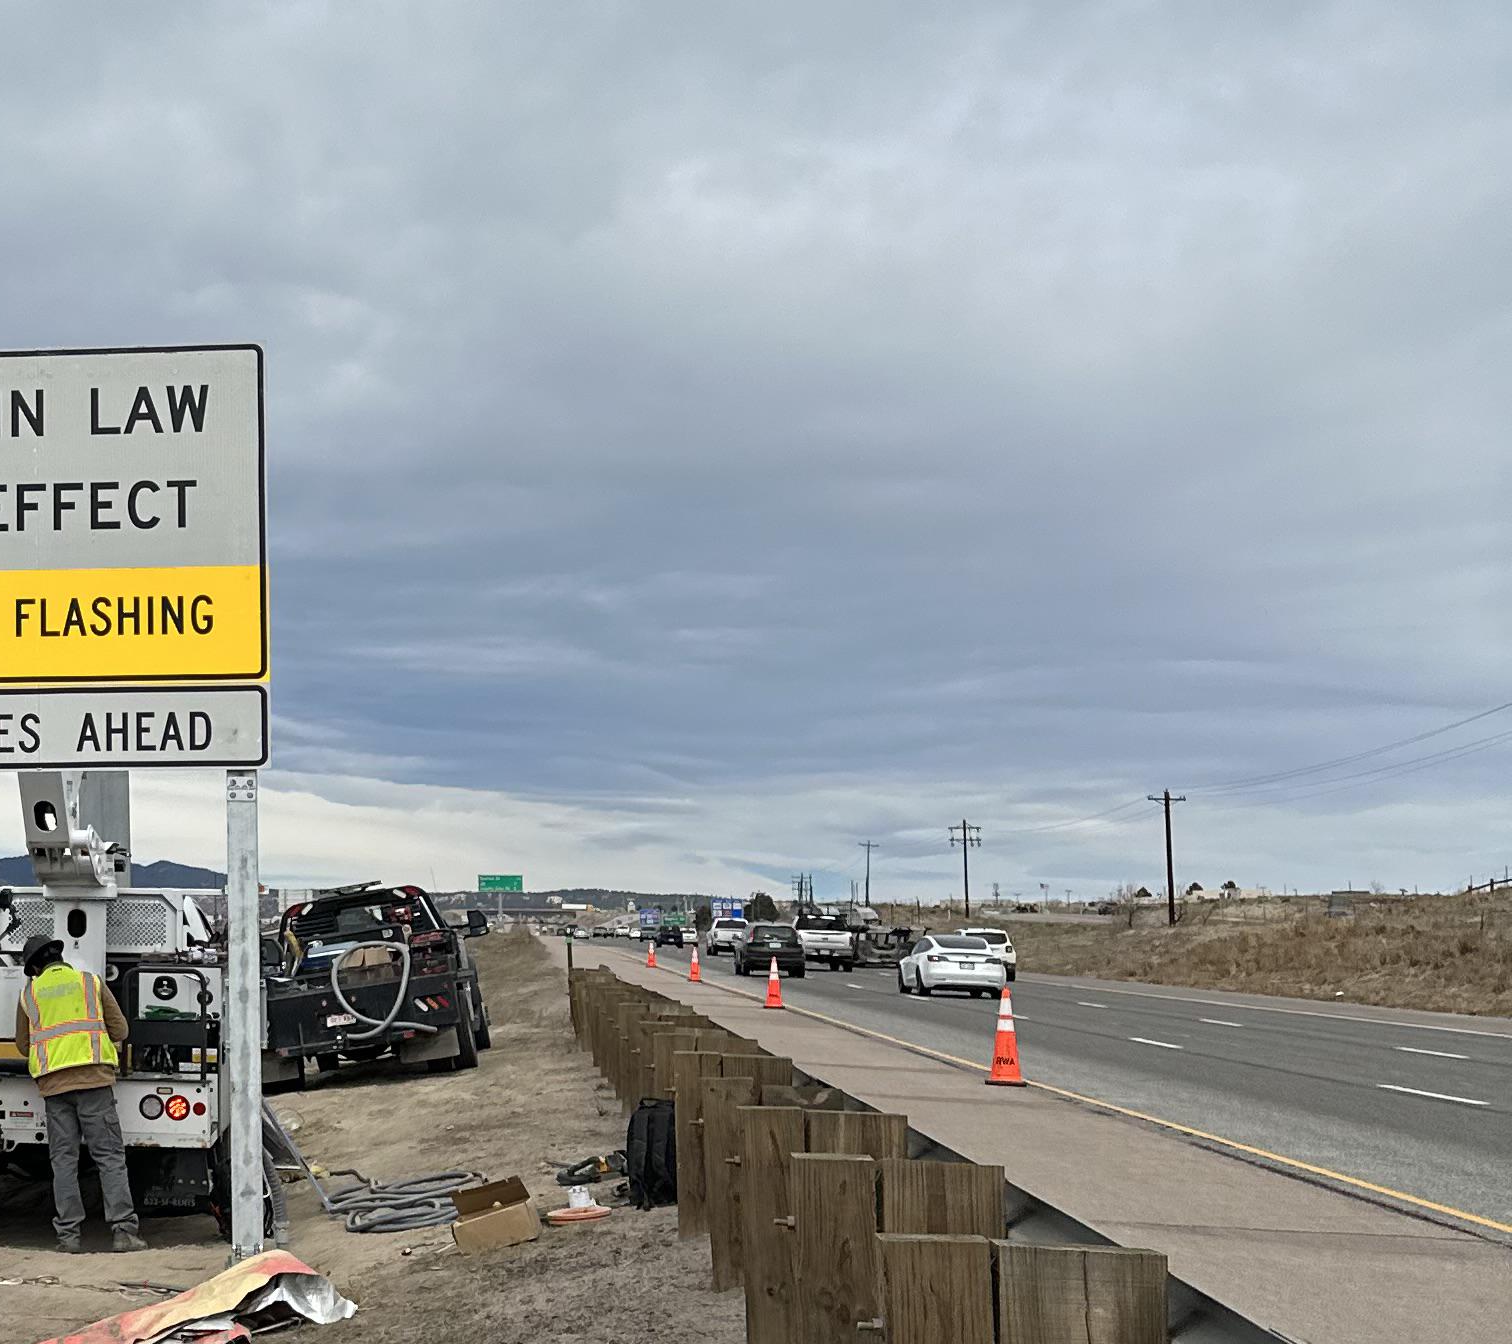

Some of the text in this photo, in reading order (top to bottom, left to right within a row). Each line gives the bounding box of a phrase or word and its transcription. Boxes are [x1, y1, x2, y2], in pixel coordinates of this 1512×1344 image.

[89, 383, 210, 436] LAW
[15, 594, 215, 639] FLASHING
[76, 710, 213, 753] AHEAD
